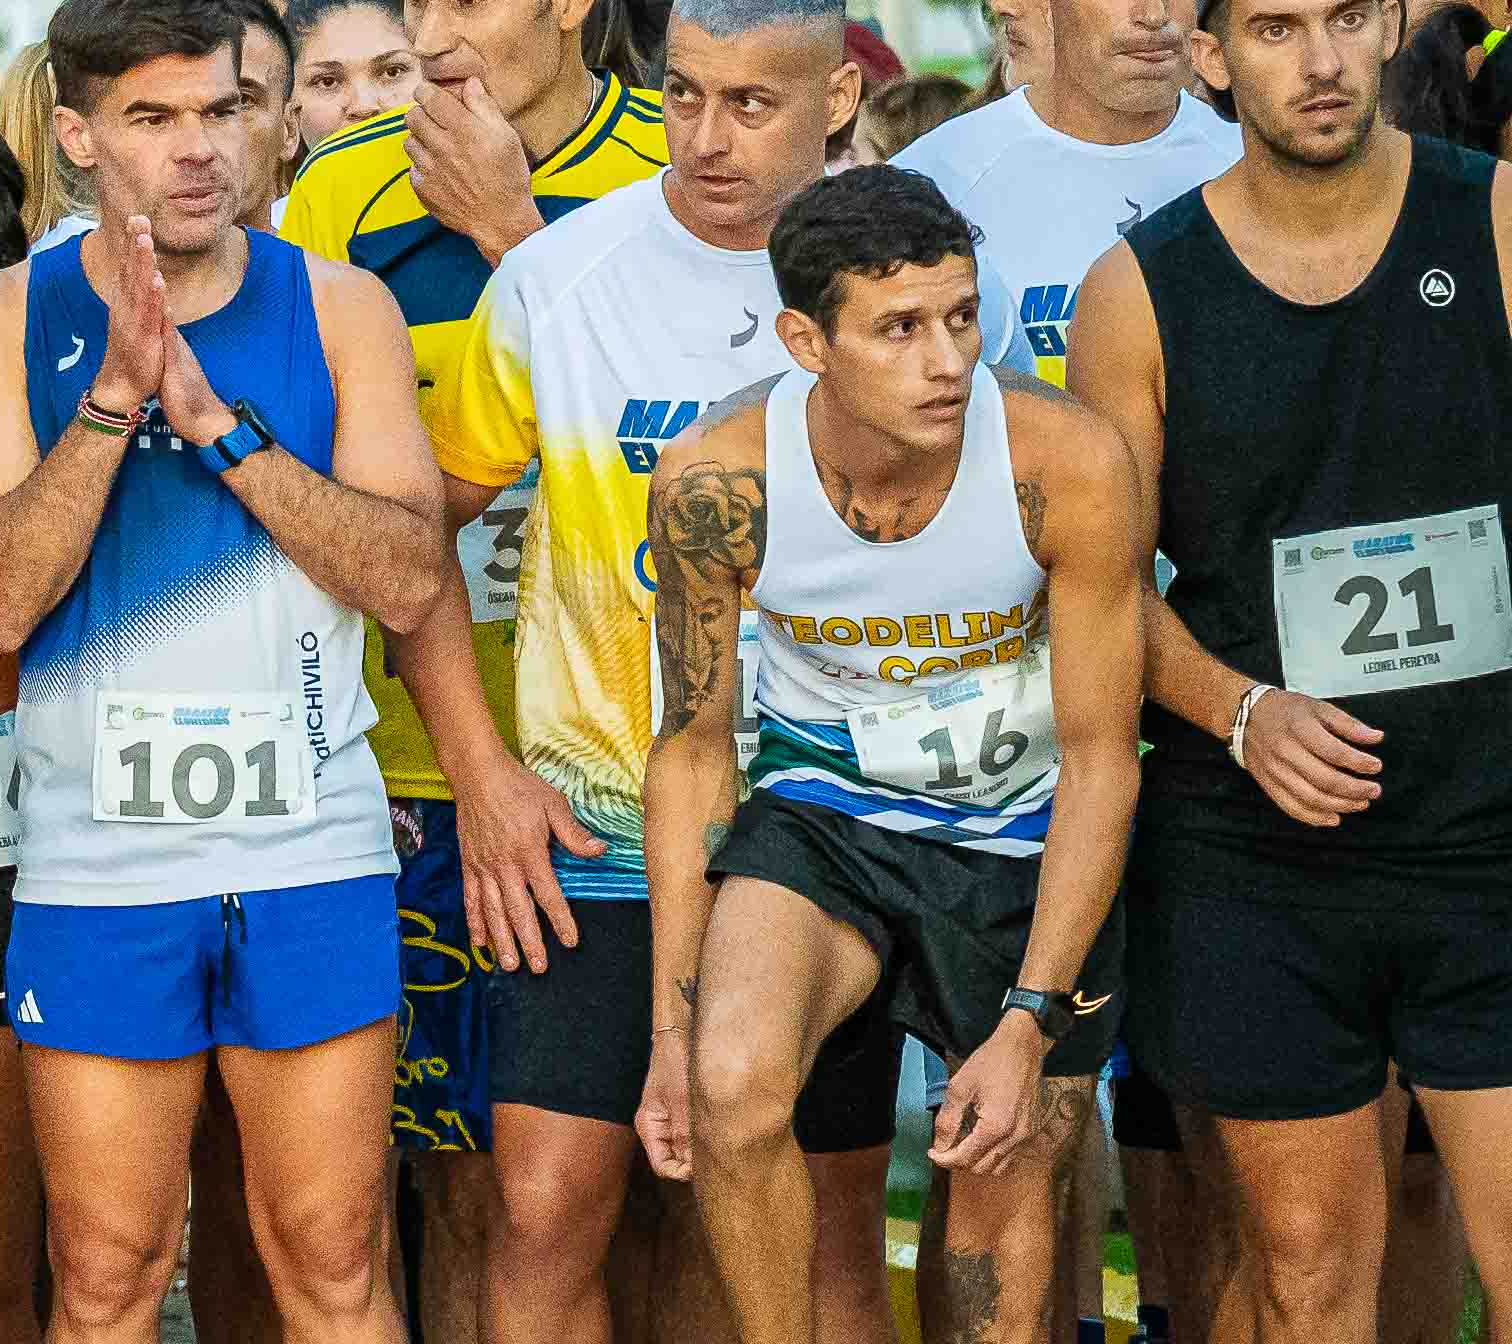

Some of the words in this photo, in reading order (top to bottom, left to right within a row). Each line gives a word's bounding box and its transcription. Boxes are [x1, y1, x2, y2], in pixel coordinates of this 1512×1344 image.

[767, 602, 1027, 649] TEODELIN
[1334, 566, 1456, 656] 21
[1401, 654, 1441, 670] PEREYRA
[119, 740, 290, 818] 101
[920, 708, 1029, 791] 16
